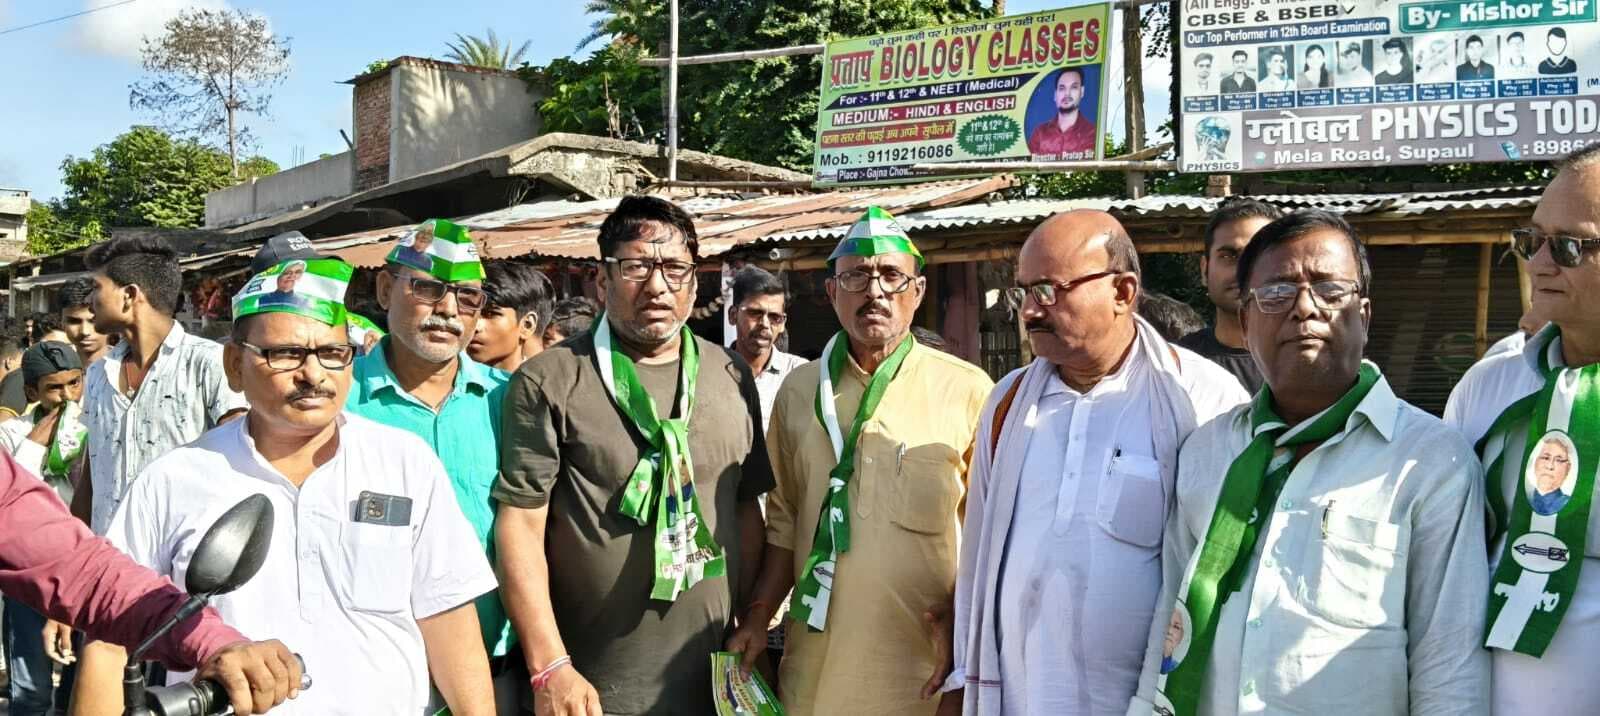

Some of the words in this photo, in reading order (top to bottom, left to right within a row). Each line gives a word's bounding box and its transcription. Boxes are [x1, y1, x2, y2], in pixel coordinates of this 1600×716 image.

[1187, 11, 1246, 27] CBSE
[1254, 10, 1269, 22] &
[1278, 4, 1339, 20] BSEB
[1408, 7, 1451, 29] By-
[1459, 1, 1543, 23] Kishor
[1552, 0, 1588, 17] Sir
[1187, 32, 1204, 44] Our
[1206, 30, 1222, 44] Top
[1224, 28, 1268, 42] Performer
[1269, 28, 1279, 39] in
[1280, 26, 1299, 38] 12th
[1301, 24, 1328, 36] Board
[1330, 19, 1387, 34] Examination
[879, 35, 982, 83] BIOLOGY
[988, 18, 1100, 72] CLASSES
[839, 96, 858, 106] For
[887, 90, 895, 100] &
[919, 86, 927, 97] &
[930, 84, 962, 96] NEET
[965, 77, 1020, 95] (Medical)
[905, 104, 941, 119] HINDI
[943, 103, 952, 114] &
[955, 97, 1015, 114] ENGLISH
[1246, 110, 1363, 145] ग्लोबल
[1371, 101, 1519, 141] PHYSICS
[820, 152, 853, 166] Mob.
[867, 144, 953, 163] 9119216086
[1062, 151, 1083, 161] Pratap
[1084, 149, 1094, 160] Sir
[1273, 149, 1324, 165] Mela
[1330, 146, 1391, 163] Road,
[1398, 143, 1475, 162] Supaul
[838, 170, 859, 181] Place
[1186, 161, 1240, 171] PHYSICS
